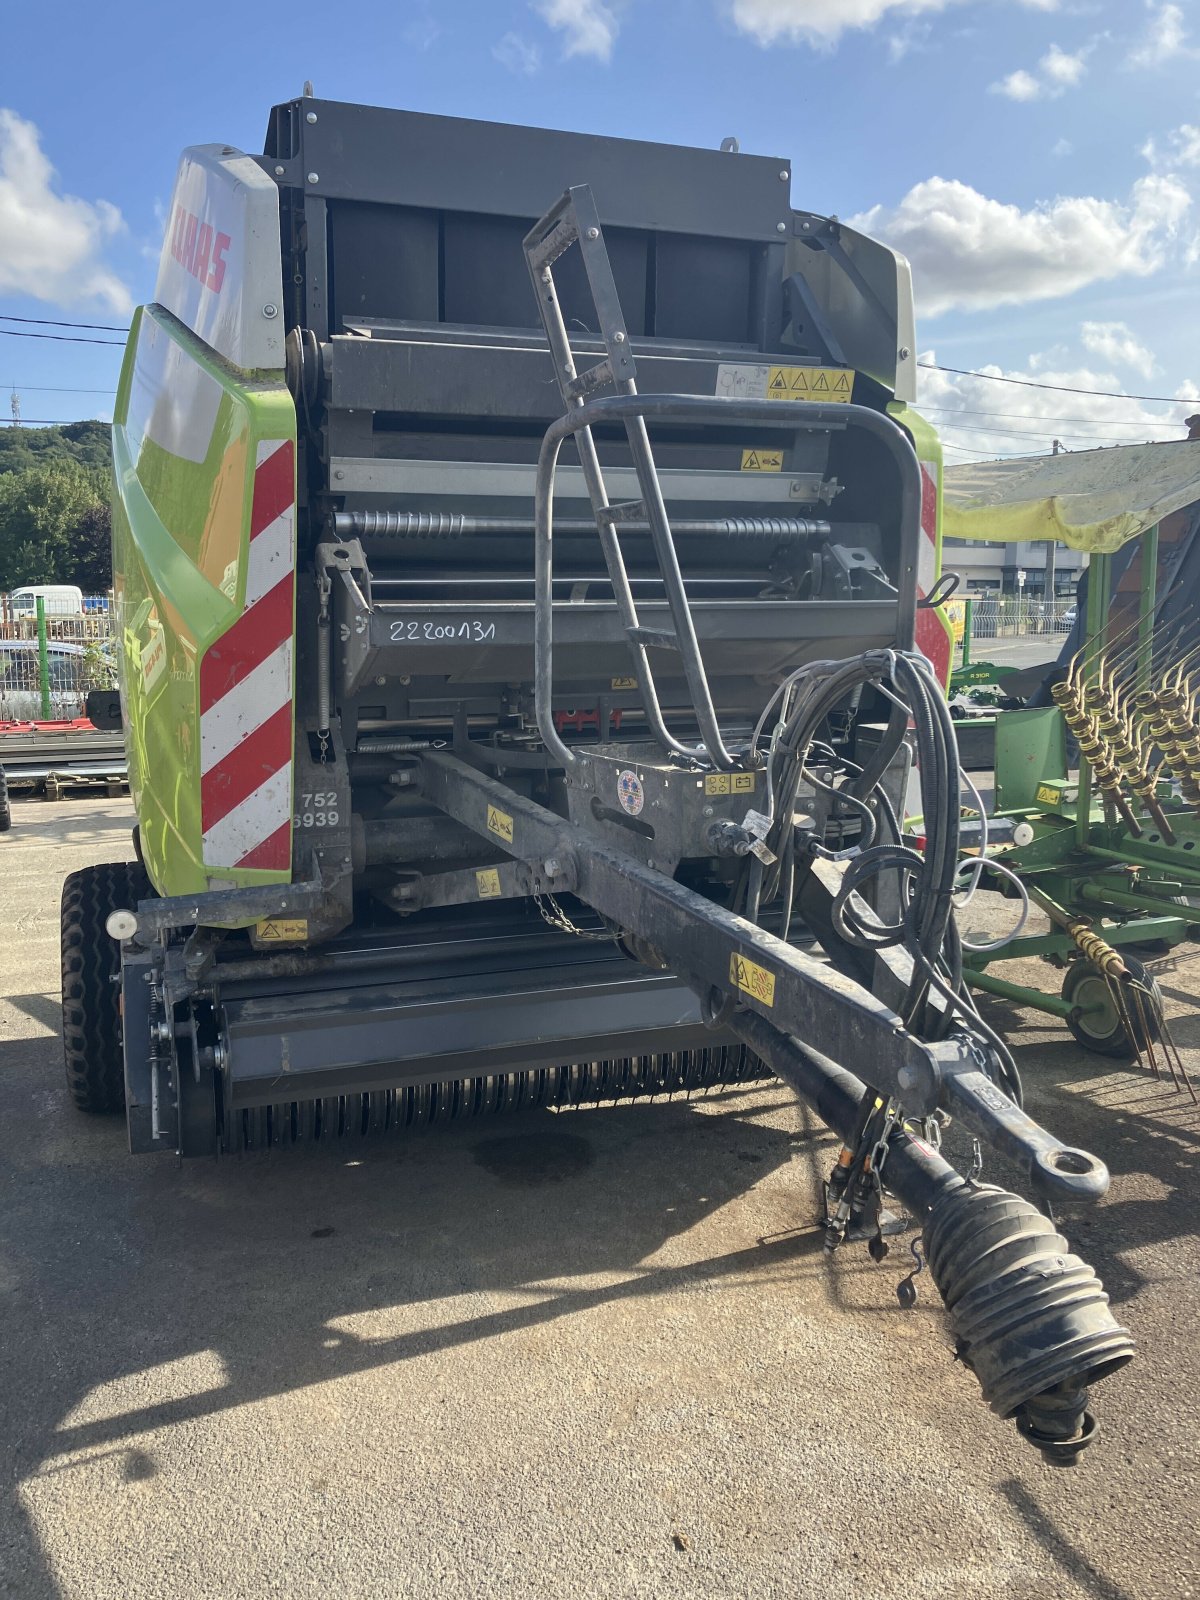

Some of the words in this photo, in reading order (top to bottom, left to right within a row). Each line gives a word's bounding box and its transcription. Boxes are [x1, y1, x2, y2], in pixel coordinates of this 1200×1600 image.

[171, 205, 231, 294] CLAAS
[390, 621, 496, 641] 22200131
[302, 791, 338, 808] 752
[293, 811, 339, 829] 6939
